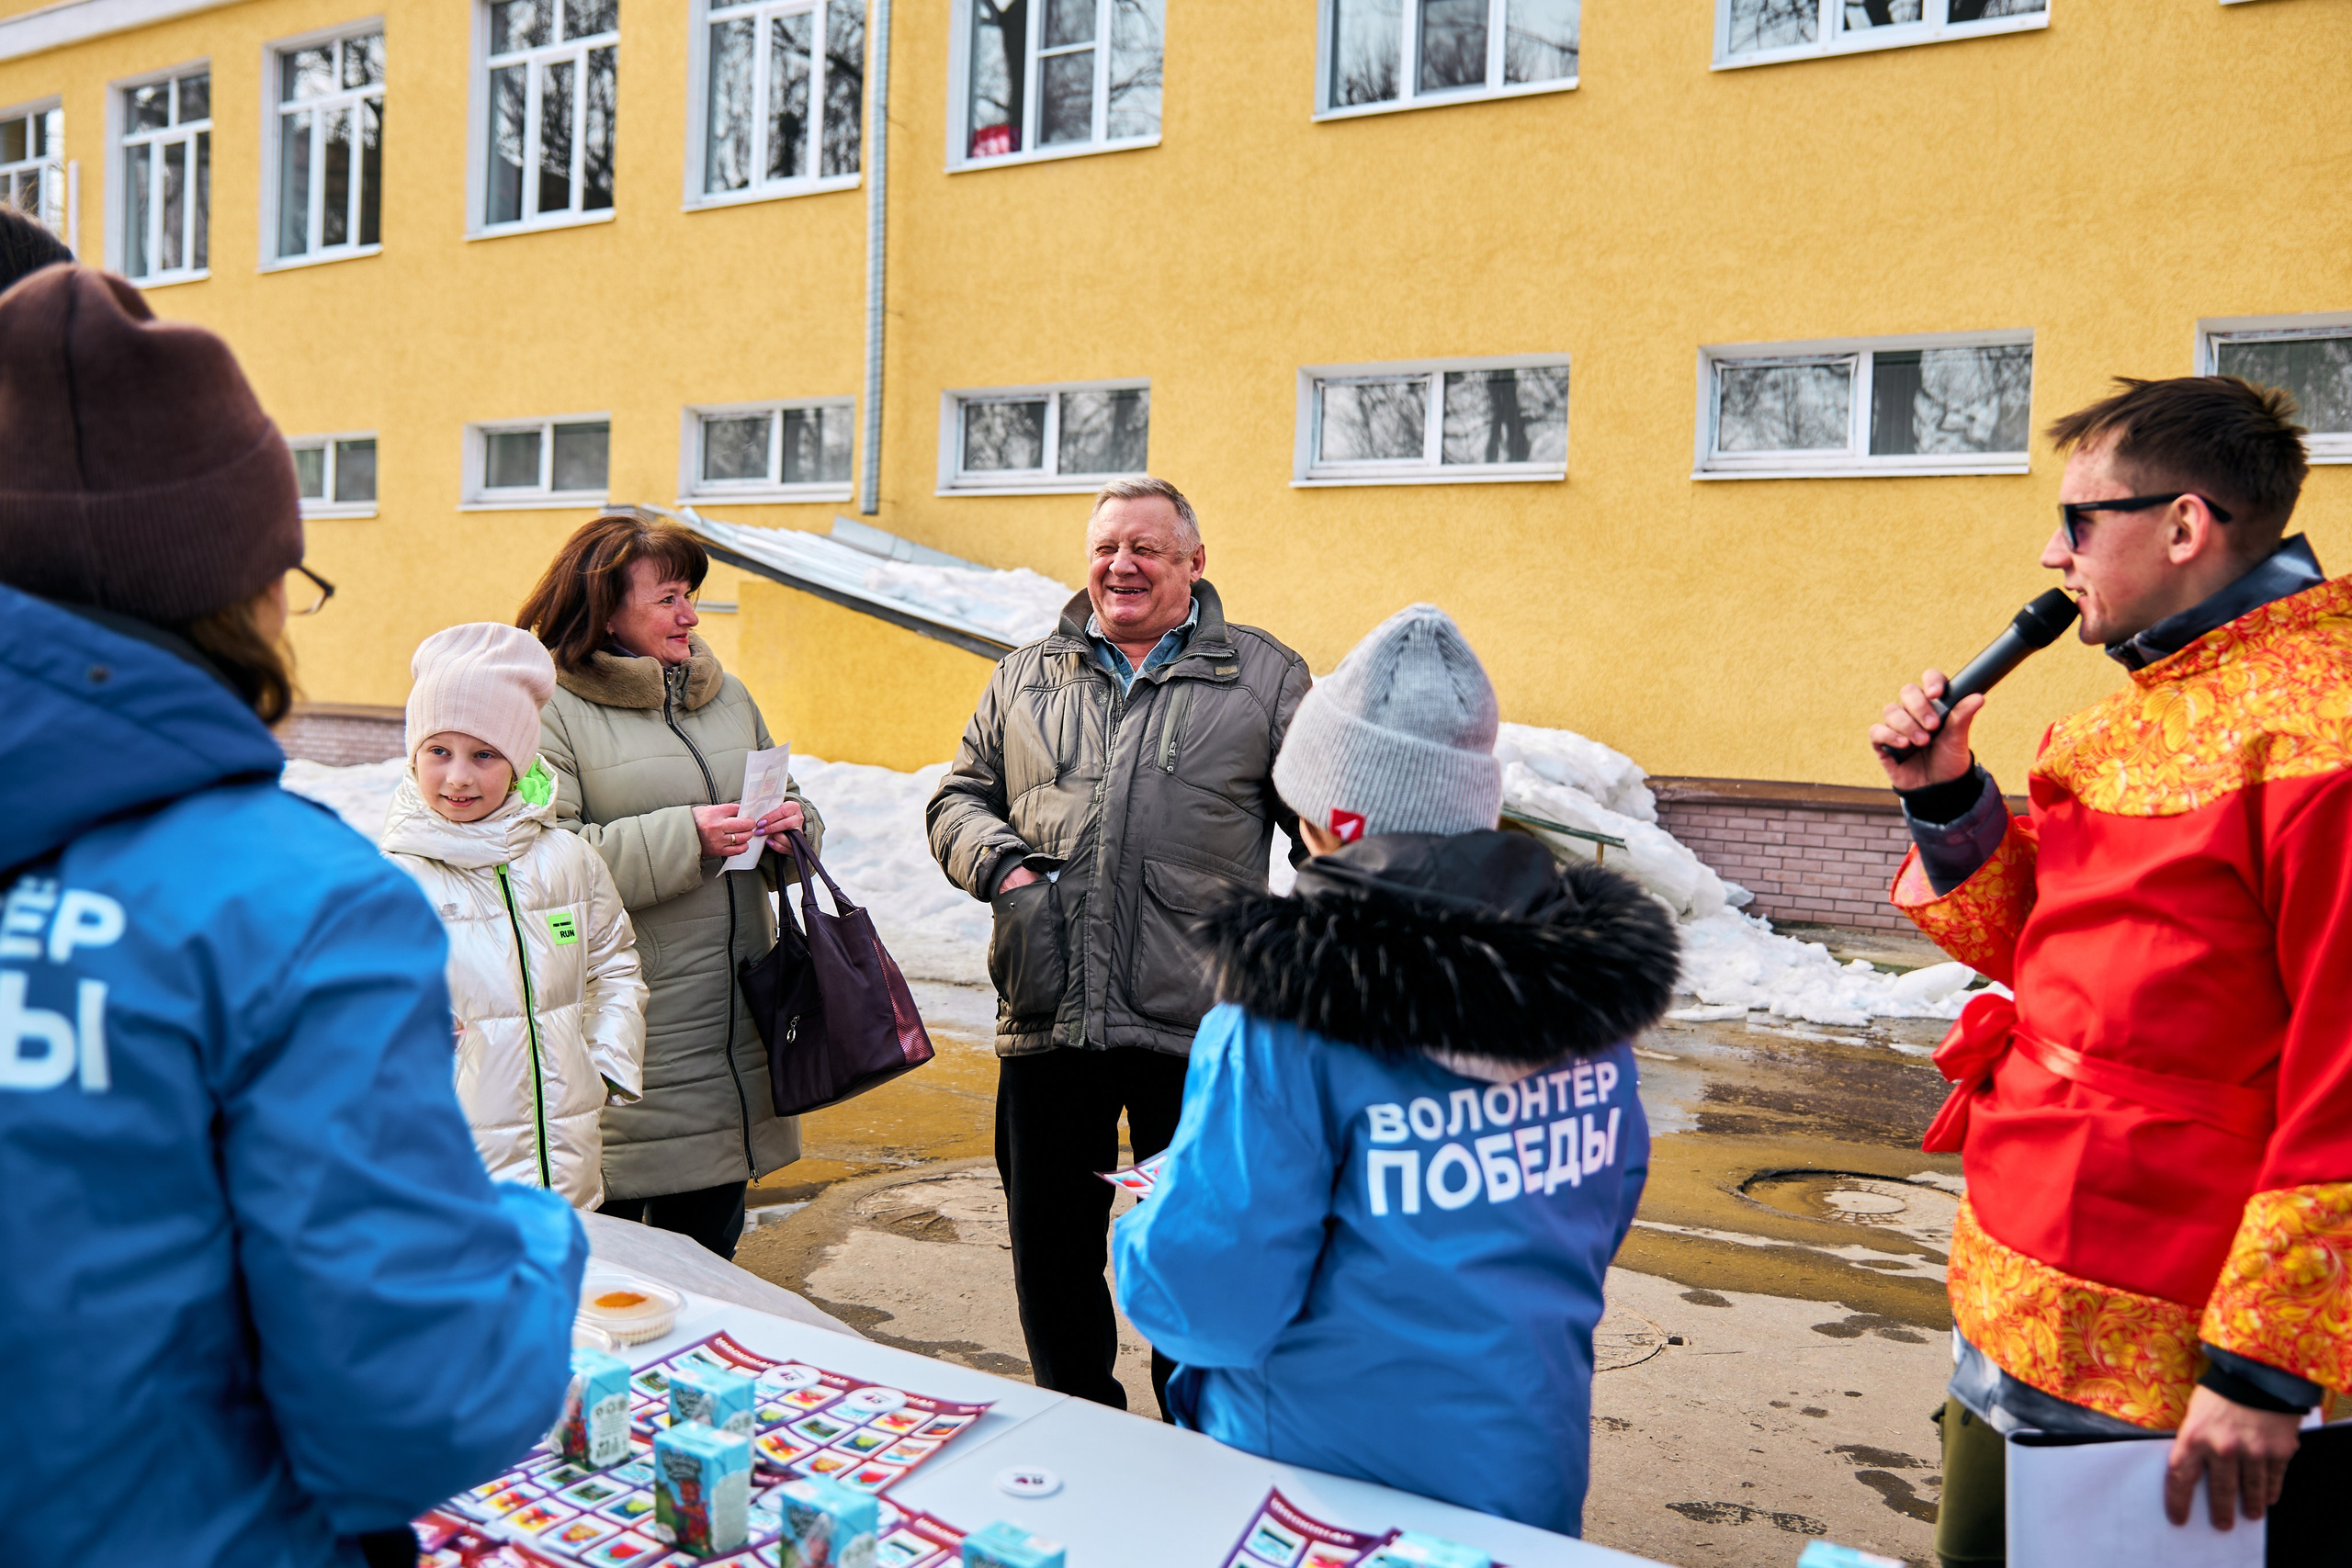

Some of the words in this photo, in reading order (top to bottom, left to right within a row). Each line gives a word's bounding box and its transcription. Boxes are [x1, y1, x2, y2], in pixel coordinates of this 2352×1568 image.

[560, 930, 575, 938] RUN
[1366, 1059, 1619, 1144] ВОЛОНТЁР
[1367, 1107, 1621, 1217] ПОБЕДЫ
